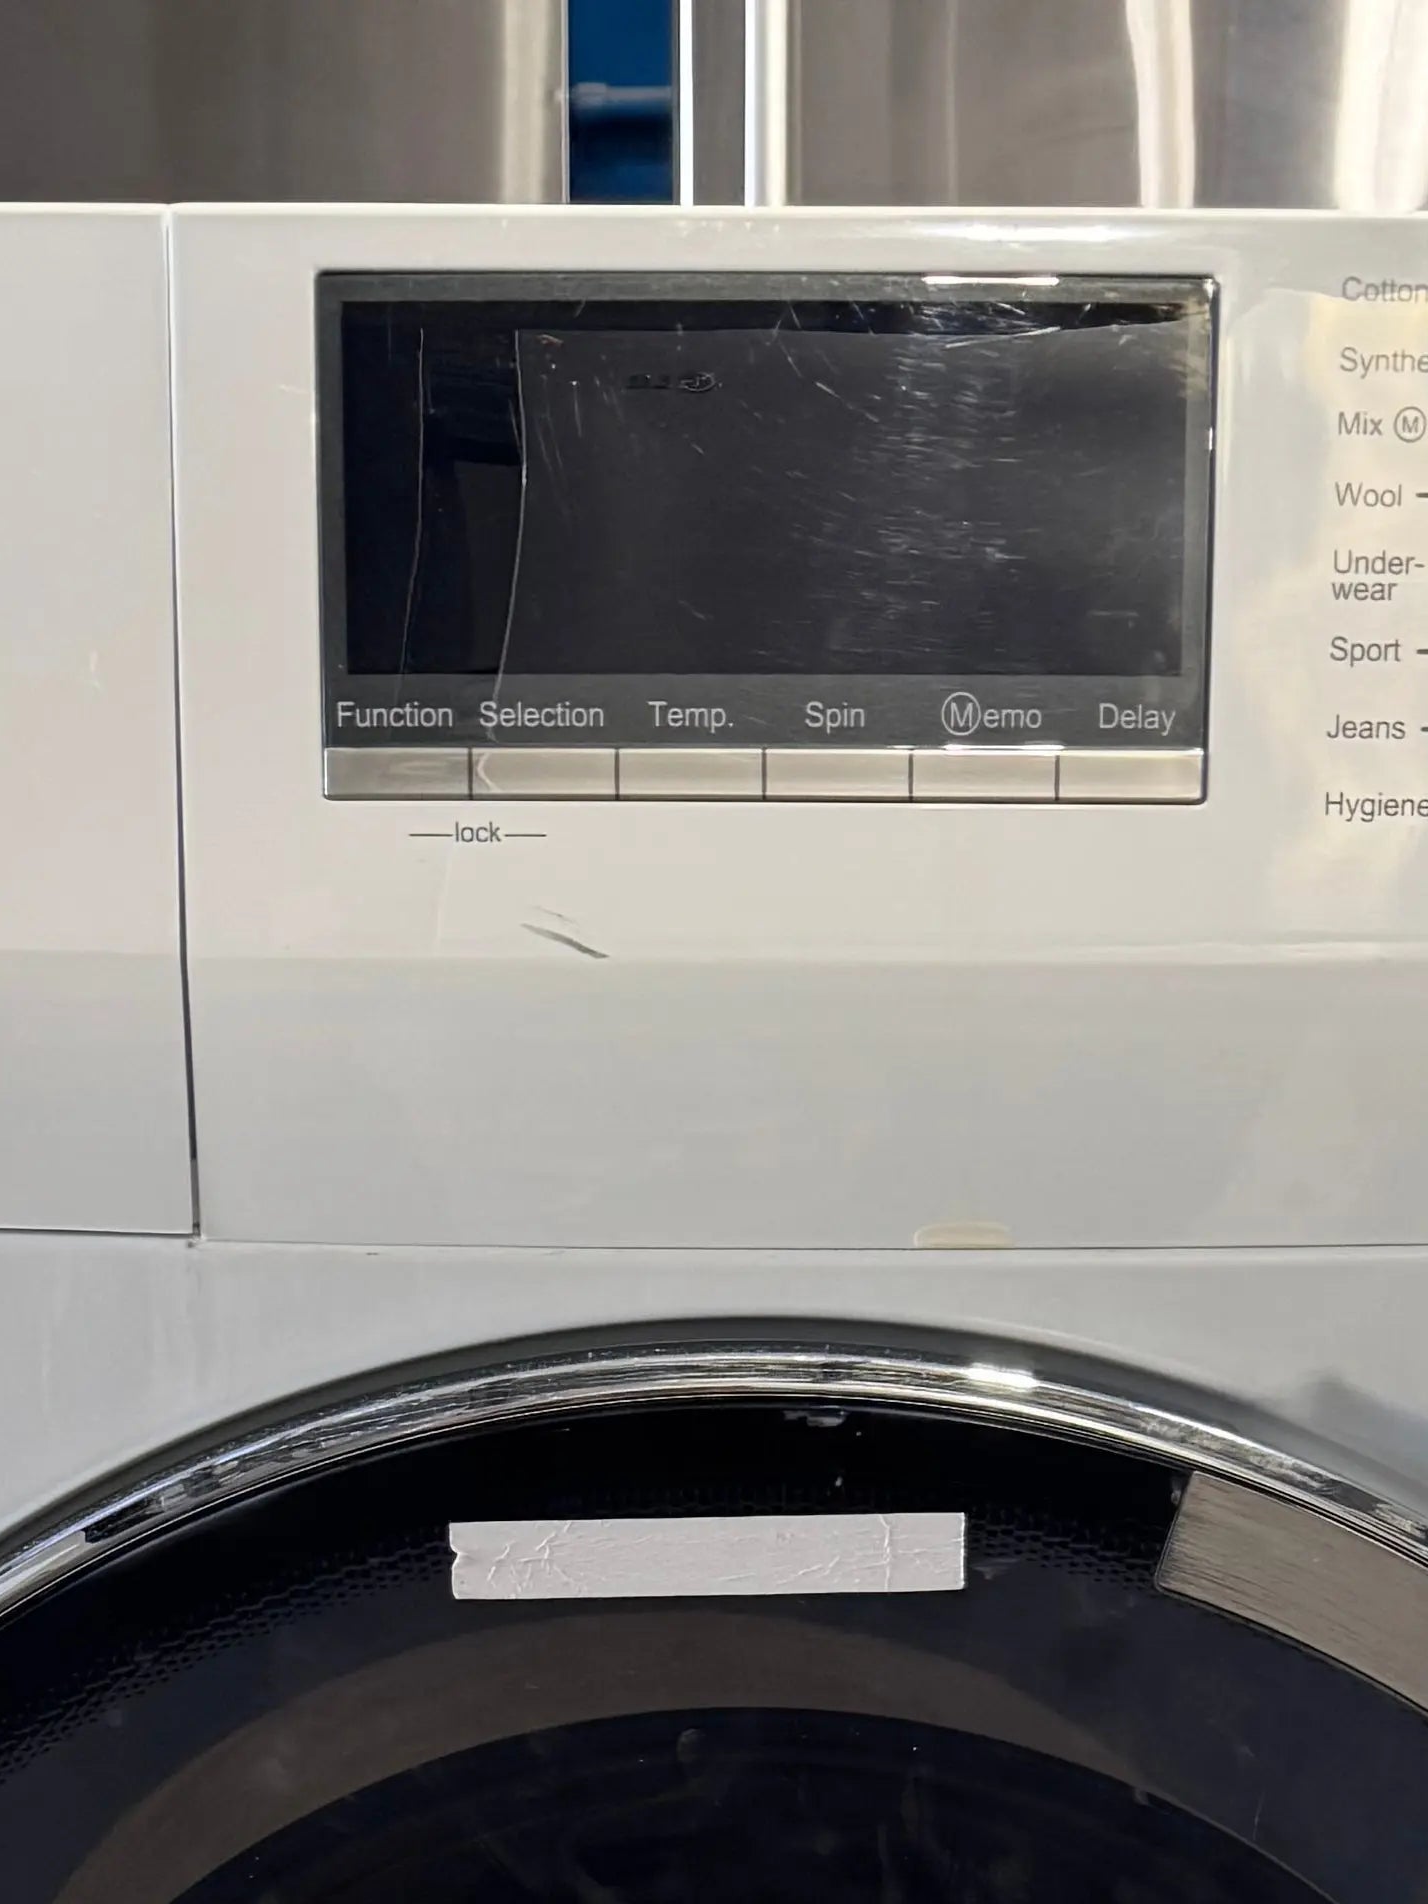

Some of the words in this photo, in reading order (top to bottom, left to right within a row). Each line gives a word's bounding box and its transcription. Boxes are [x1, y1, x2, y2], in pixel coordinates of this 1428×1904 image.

[1337, 412, 1384, 437] Mix
[1335, 483, 1403, 508] Wool
[1333, 550, 1425, 577] Under-
[1333, 580, 1397, 602] wear
[1330, 637, 1401, 667] Sport
[337, 701, 453, 731] Function
[479, 700, 604, 729] Selection
[648, 701, 733, 733] Temp.
[805, 701, 865, 734] Spin
[1098, 702, 1176, 733] Delay
[1326, 716, 1406, 741] Jeans
[454, 819, 501, 844] lock
